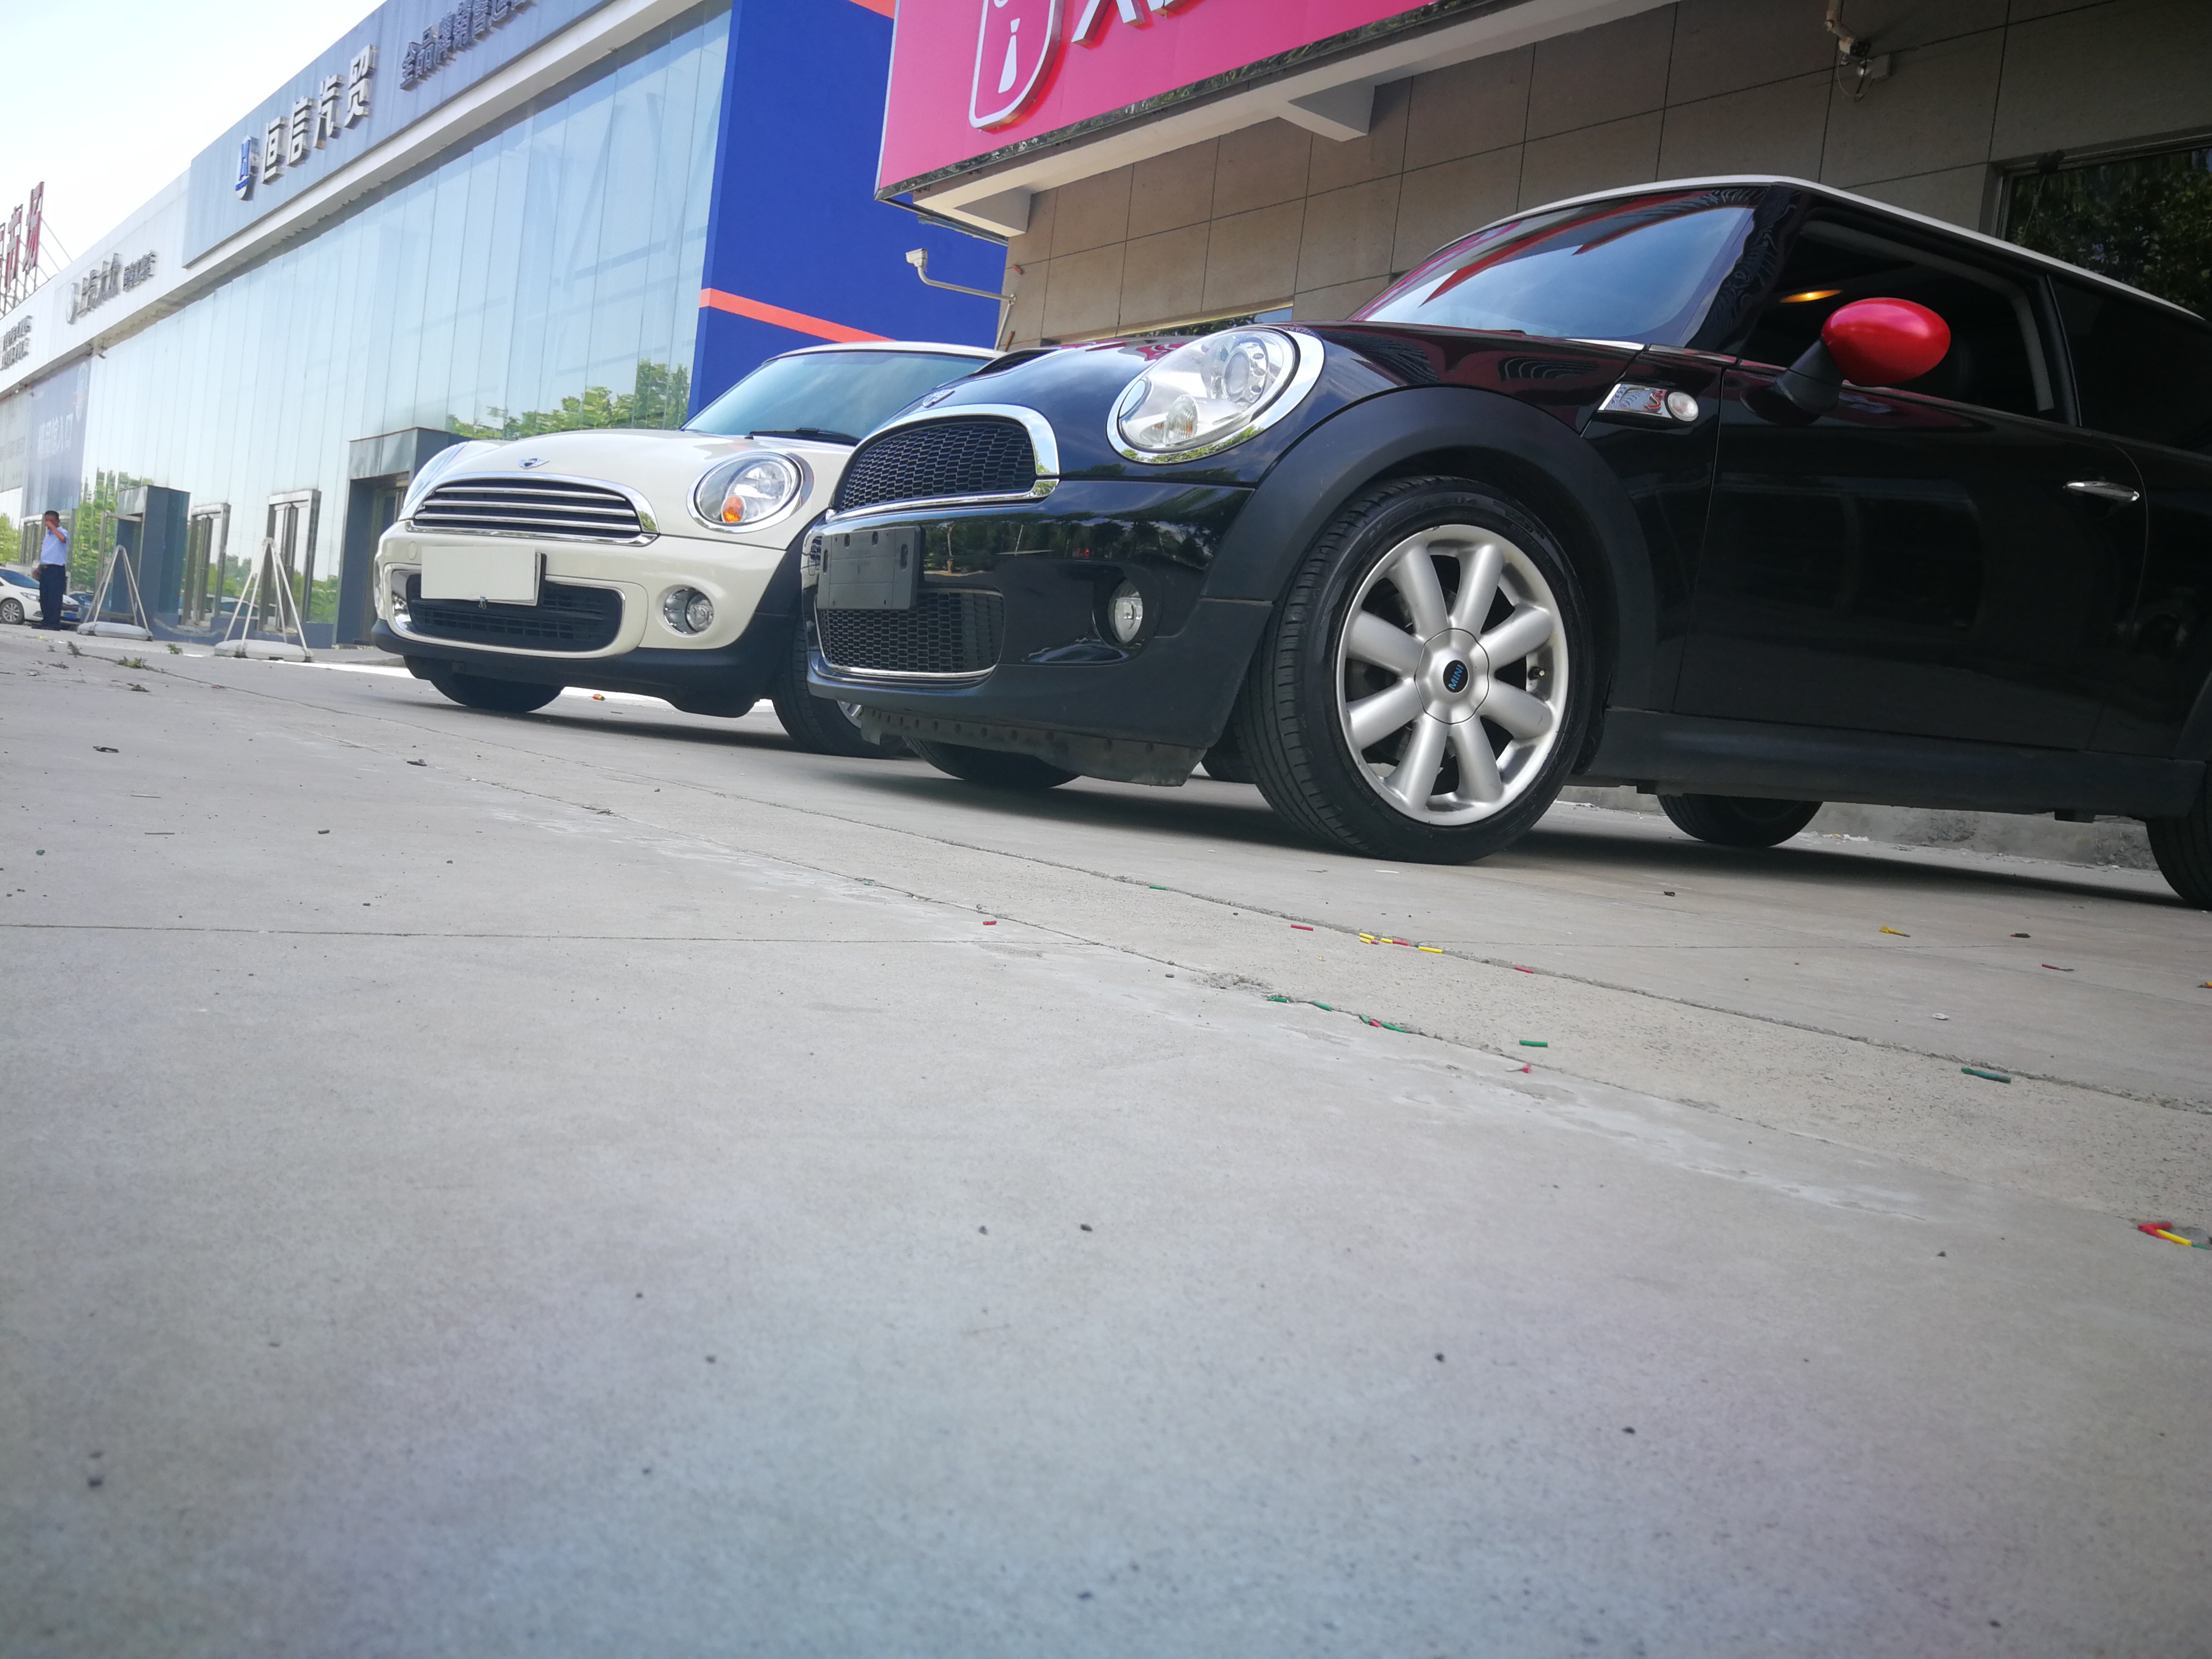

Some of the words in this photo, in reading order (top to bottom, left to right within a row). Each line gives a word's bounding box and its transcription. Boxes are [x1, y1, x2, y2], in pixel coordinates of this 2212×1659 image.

[400, 0, 531, 90] 全品牌销售
[261, 43, 377, 185] 恒信汽贸
[0, 181, 45, 293] 市场
[1448, 664, 1463, 690] MINI
